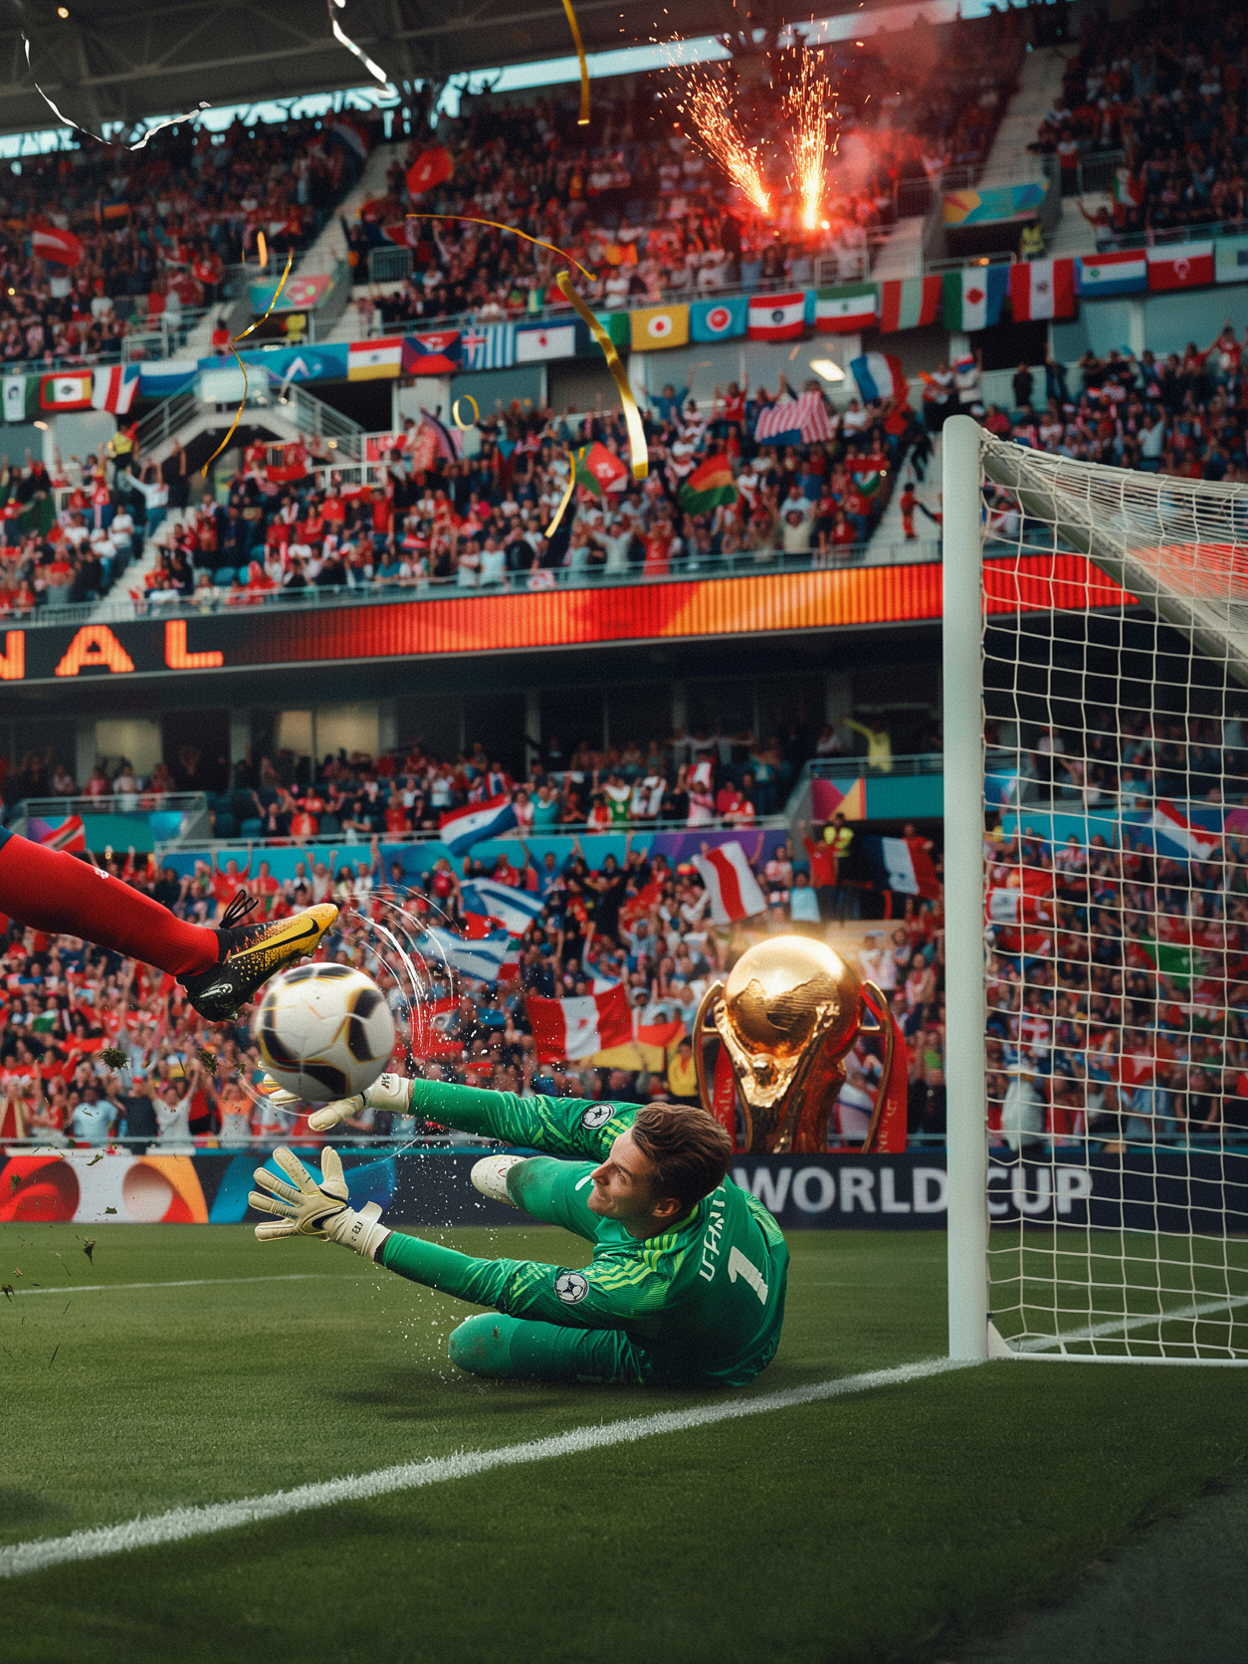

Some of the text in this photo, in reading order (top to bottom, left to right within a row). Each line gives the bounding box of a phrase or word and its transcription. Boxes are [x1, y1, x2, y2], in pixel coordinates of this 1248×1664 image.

[731, 1166, 1093, 1215] WORLD CUP
[728, 1246, 769, 1306] 1
